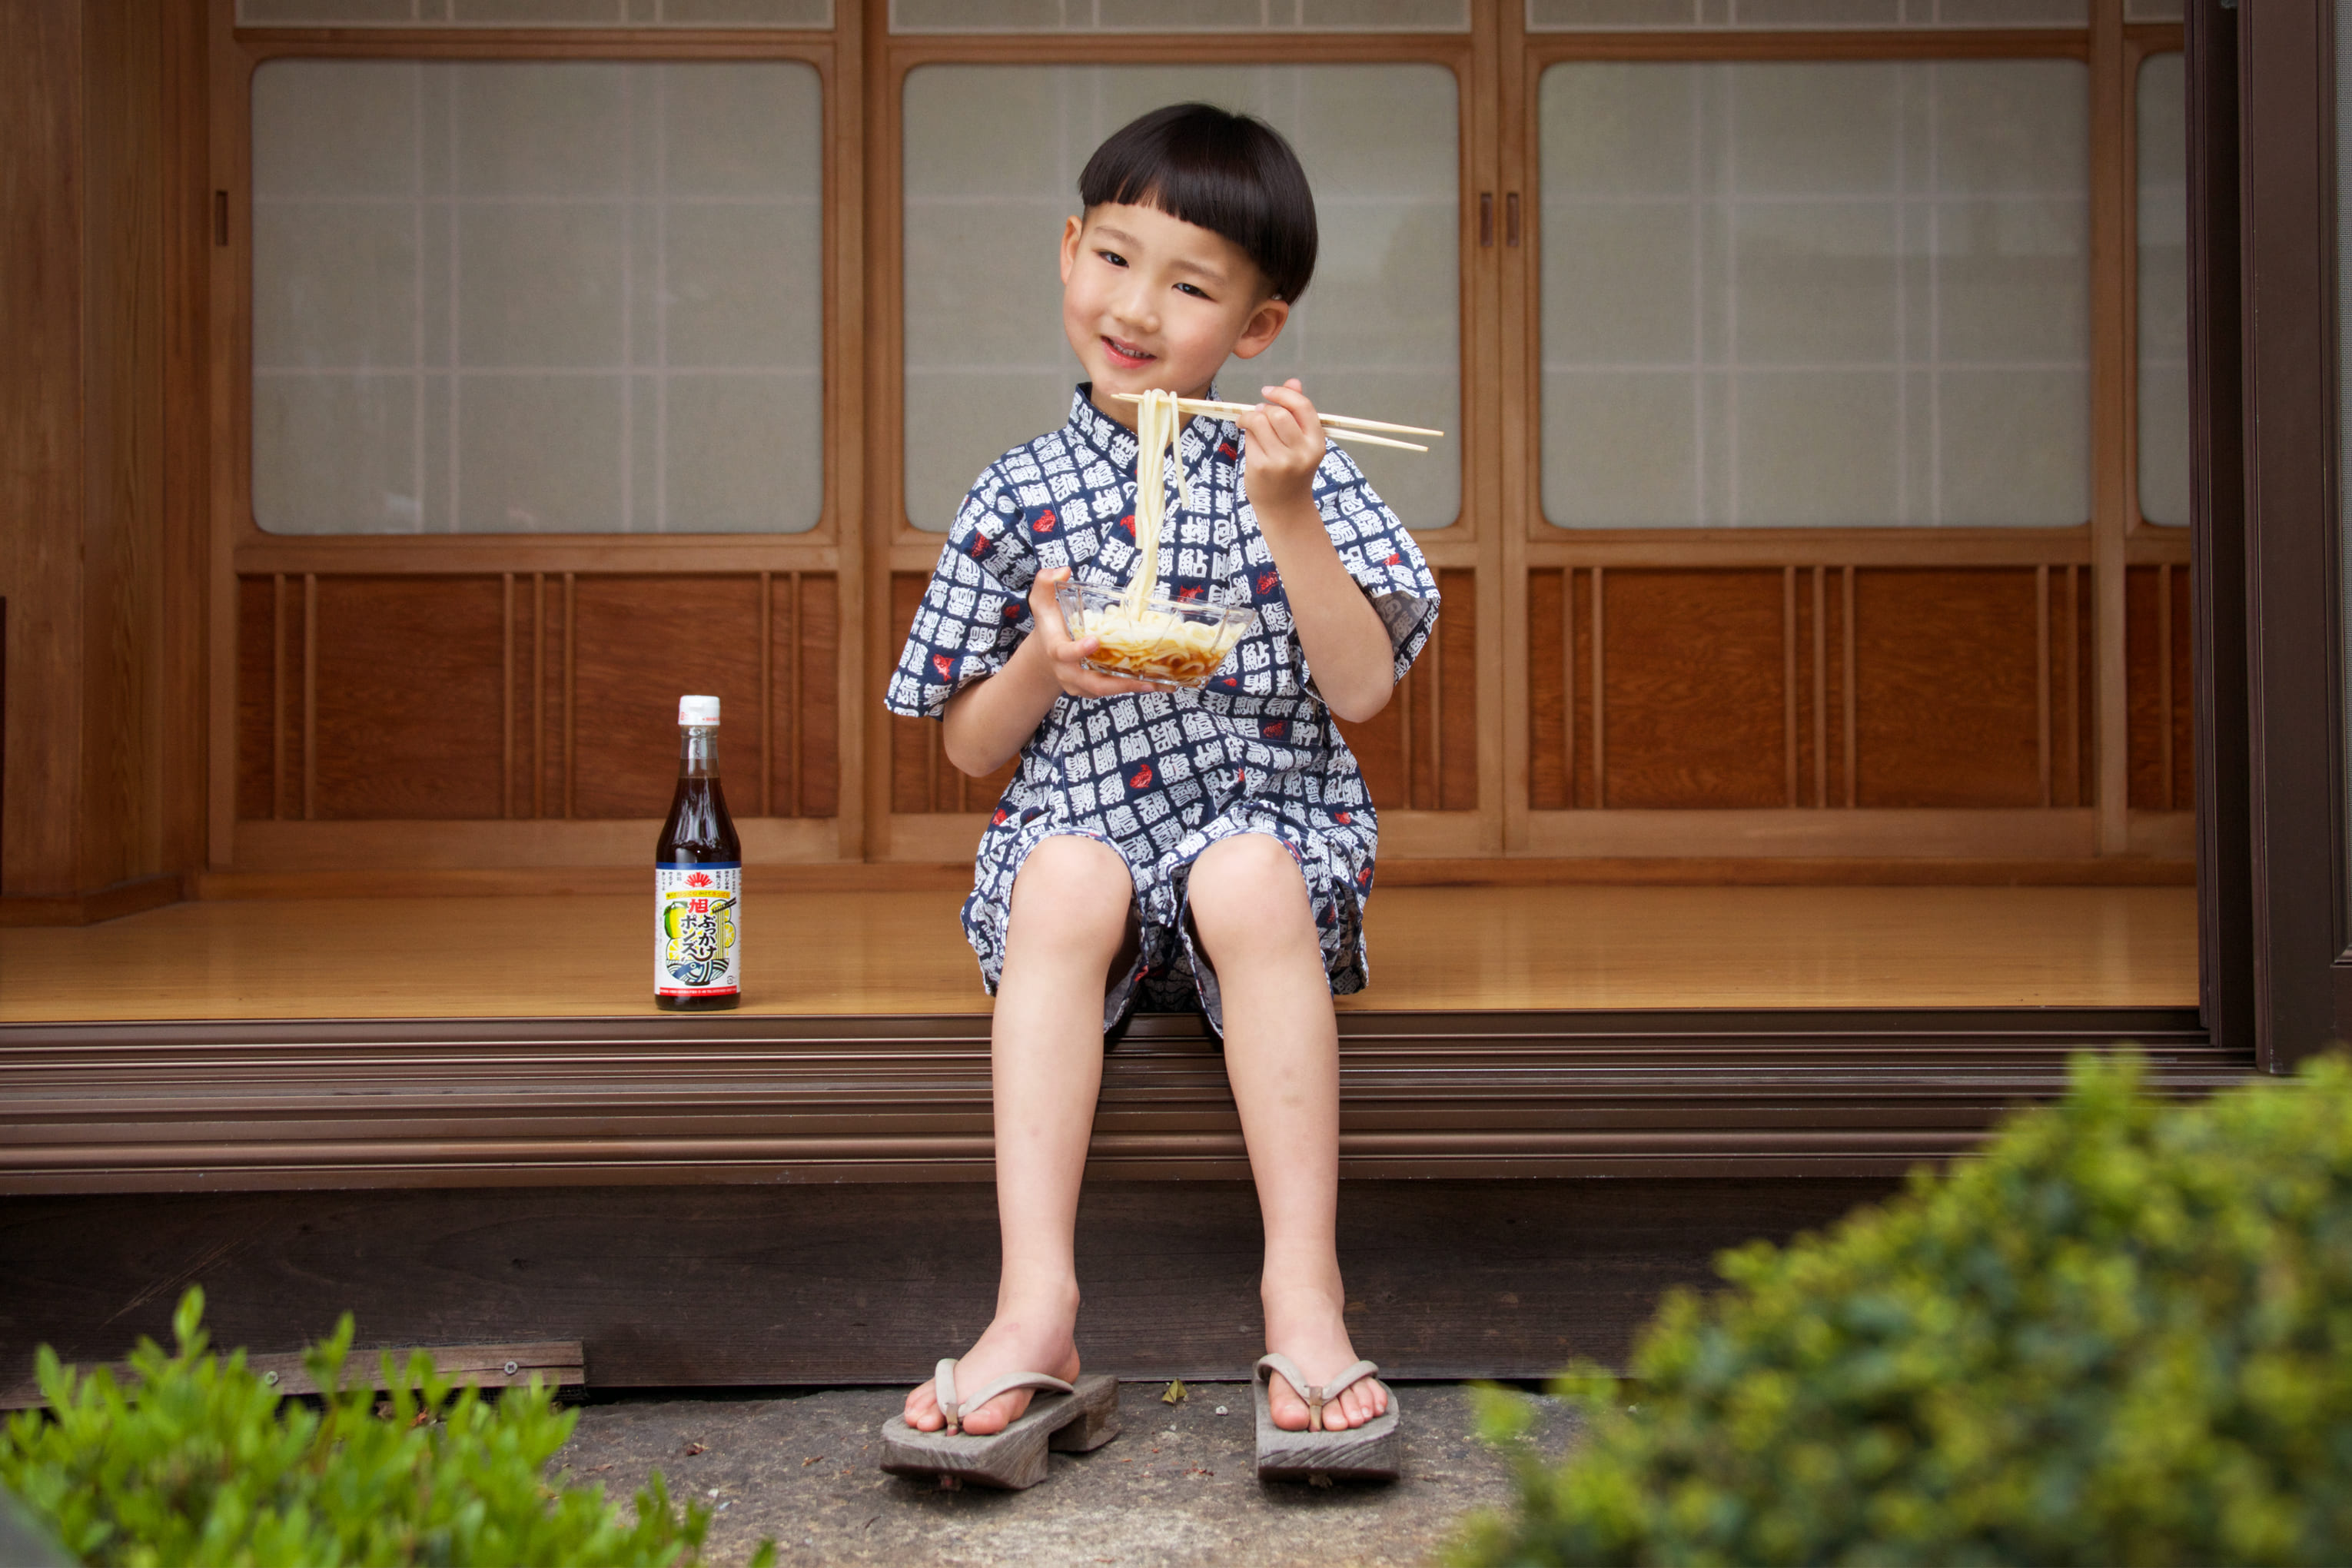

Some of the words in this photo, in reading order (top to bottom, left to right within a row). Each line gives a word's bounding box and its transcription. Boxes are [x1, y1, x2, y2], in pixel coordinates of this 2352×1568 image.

[1178, 548, 1208, 577] 鮎
[1242, 641, 1270, 672] 鮎
[688, 899, 709, 913] 旭
[681, 915, 697, 954] ポンズ
[688, 915, 717, 962] ぶっかけ
